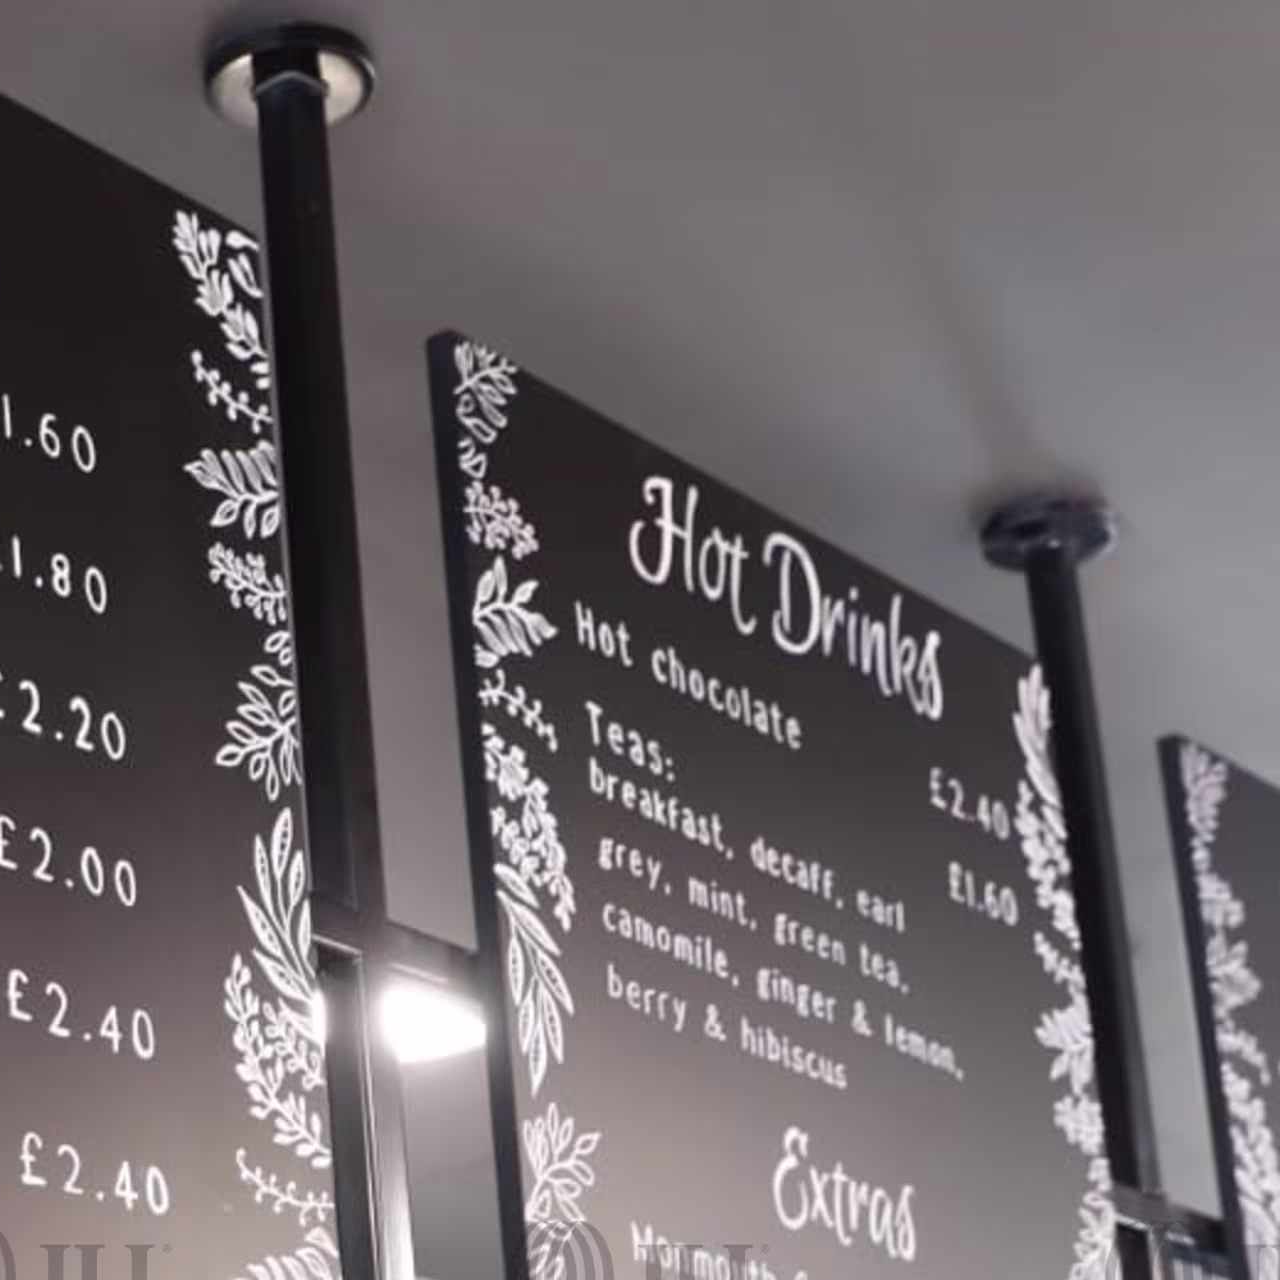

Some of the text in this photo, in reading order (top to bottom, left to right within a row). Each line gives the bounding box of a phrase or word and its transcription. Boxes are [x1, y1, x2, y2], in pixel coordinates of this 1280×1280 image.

[629, 476, 944, 721] Hot Drinks
[575, 601, 1010, 840] Hot chocolate £2.40
[584, 700, 1018, 926] Teas: £1.60
[774, 913, 846, 965] green
[856, 890, 905, 932] earl
[6, 968, 155, 1060] £2.40
[607, 963, 848, 1089] berry & hibiscus
[756, 968, 836, 1022] ginger
[851, 1000, 873, 1037] &
[19, 1131, 170, 1215] £2.40
[772, 1126, 916, 1261] Extras
